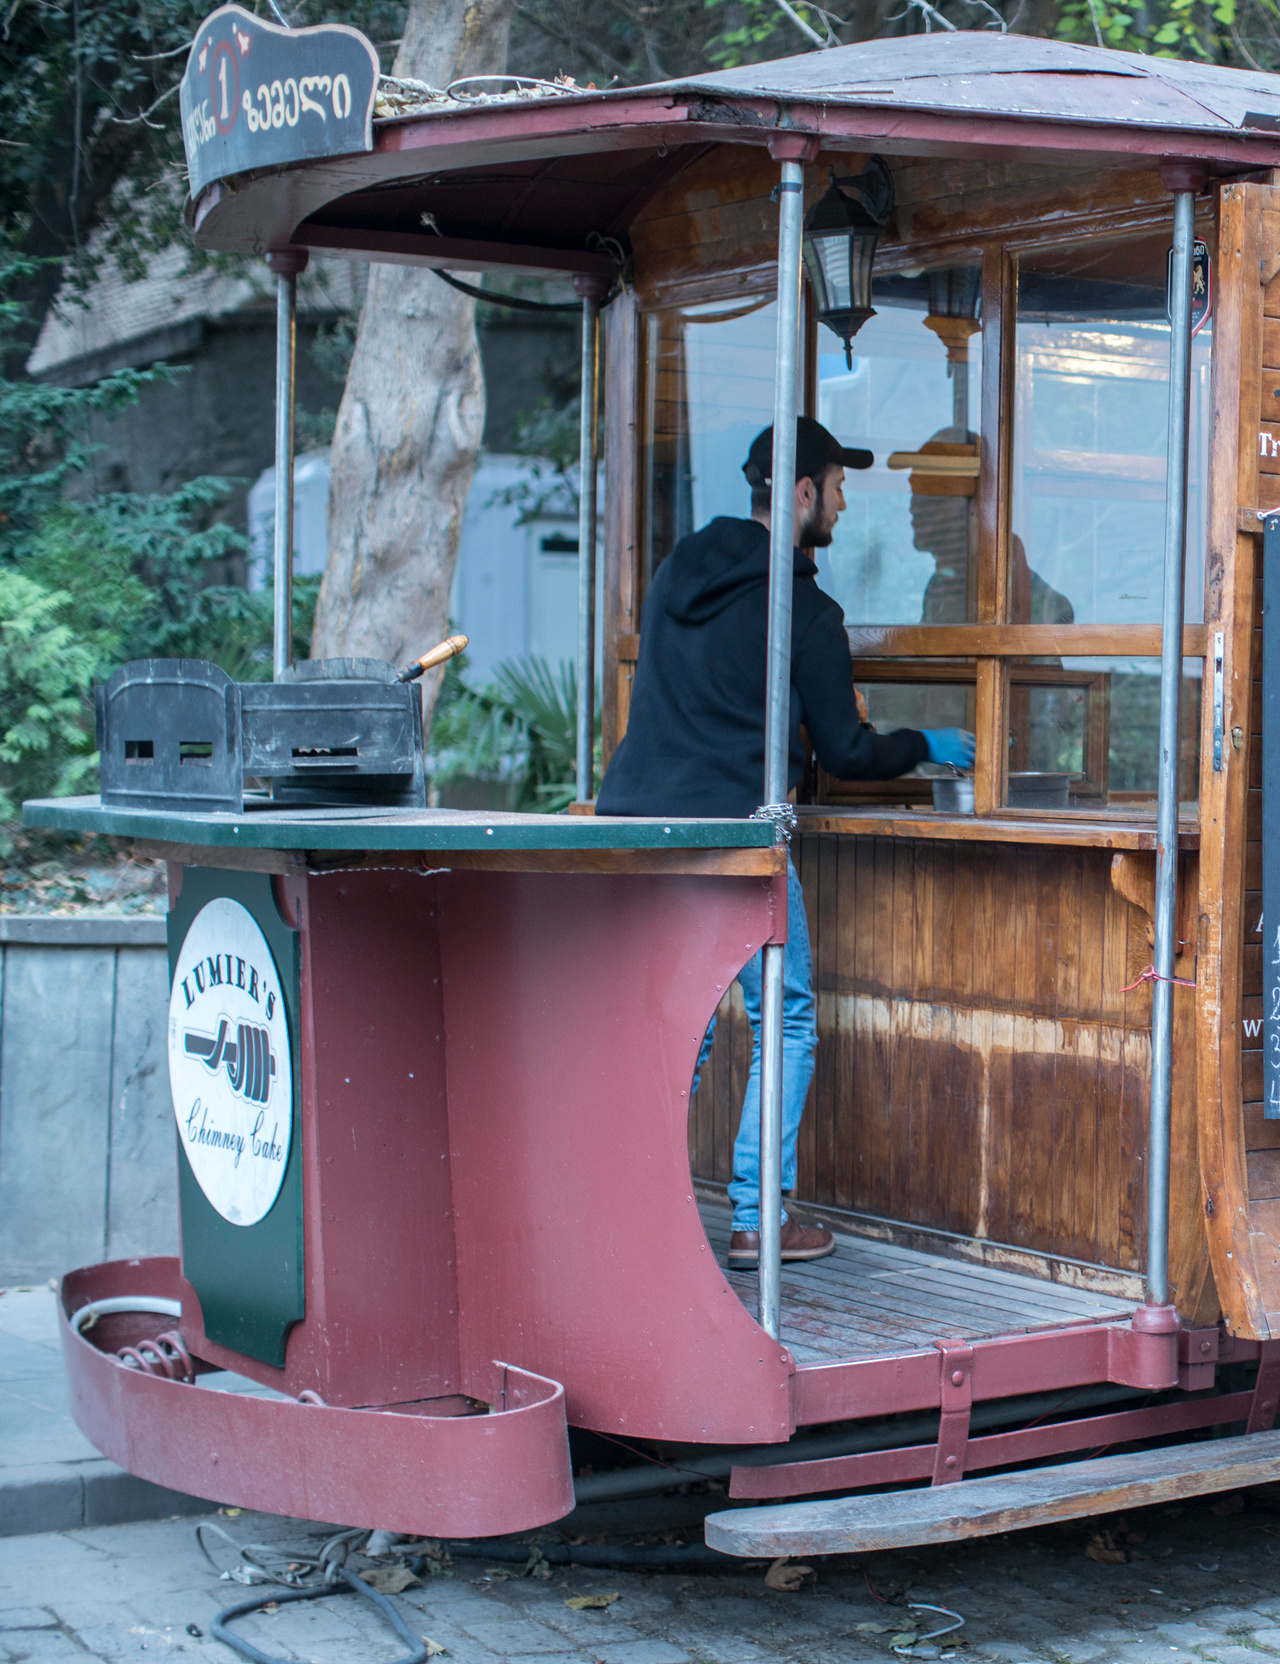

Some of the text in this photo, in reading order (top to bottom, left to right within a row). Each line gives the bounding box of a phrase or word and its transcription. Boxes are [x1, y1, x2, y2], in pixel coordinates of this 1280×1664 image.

[218, 56, 228, 120] 1
[242, 73, 351, 133] ზემელი
[181, 953, 276, 1022] LUMIER'S
[185, 1097, 284, 1169] Chimney Cake
